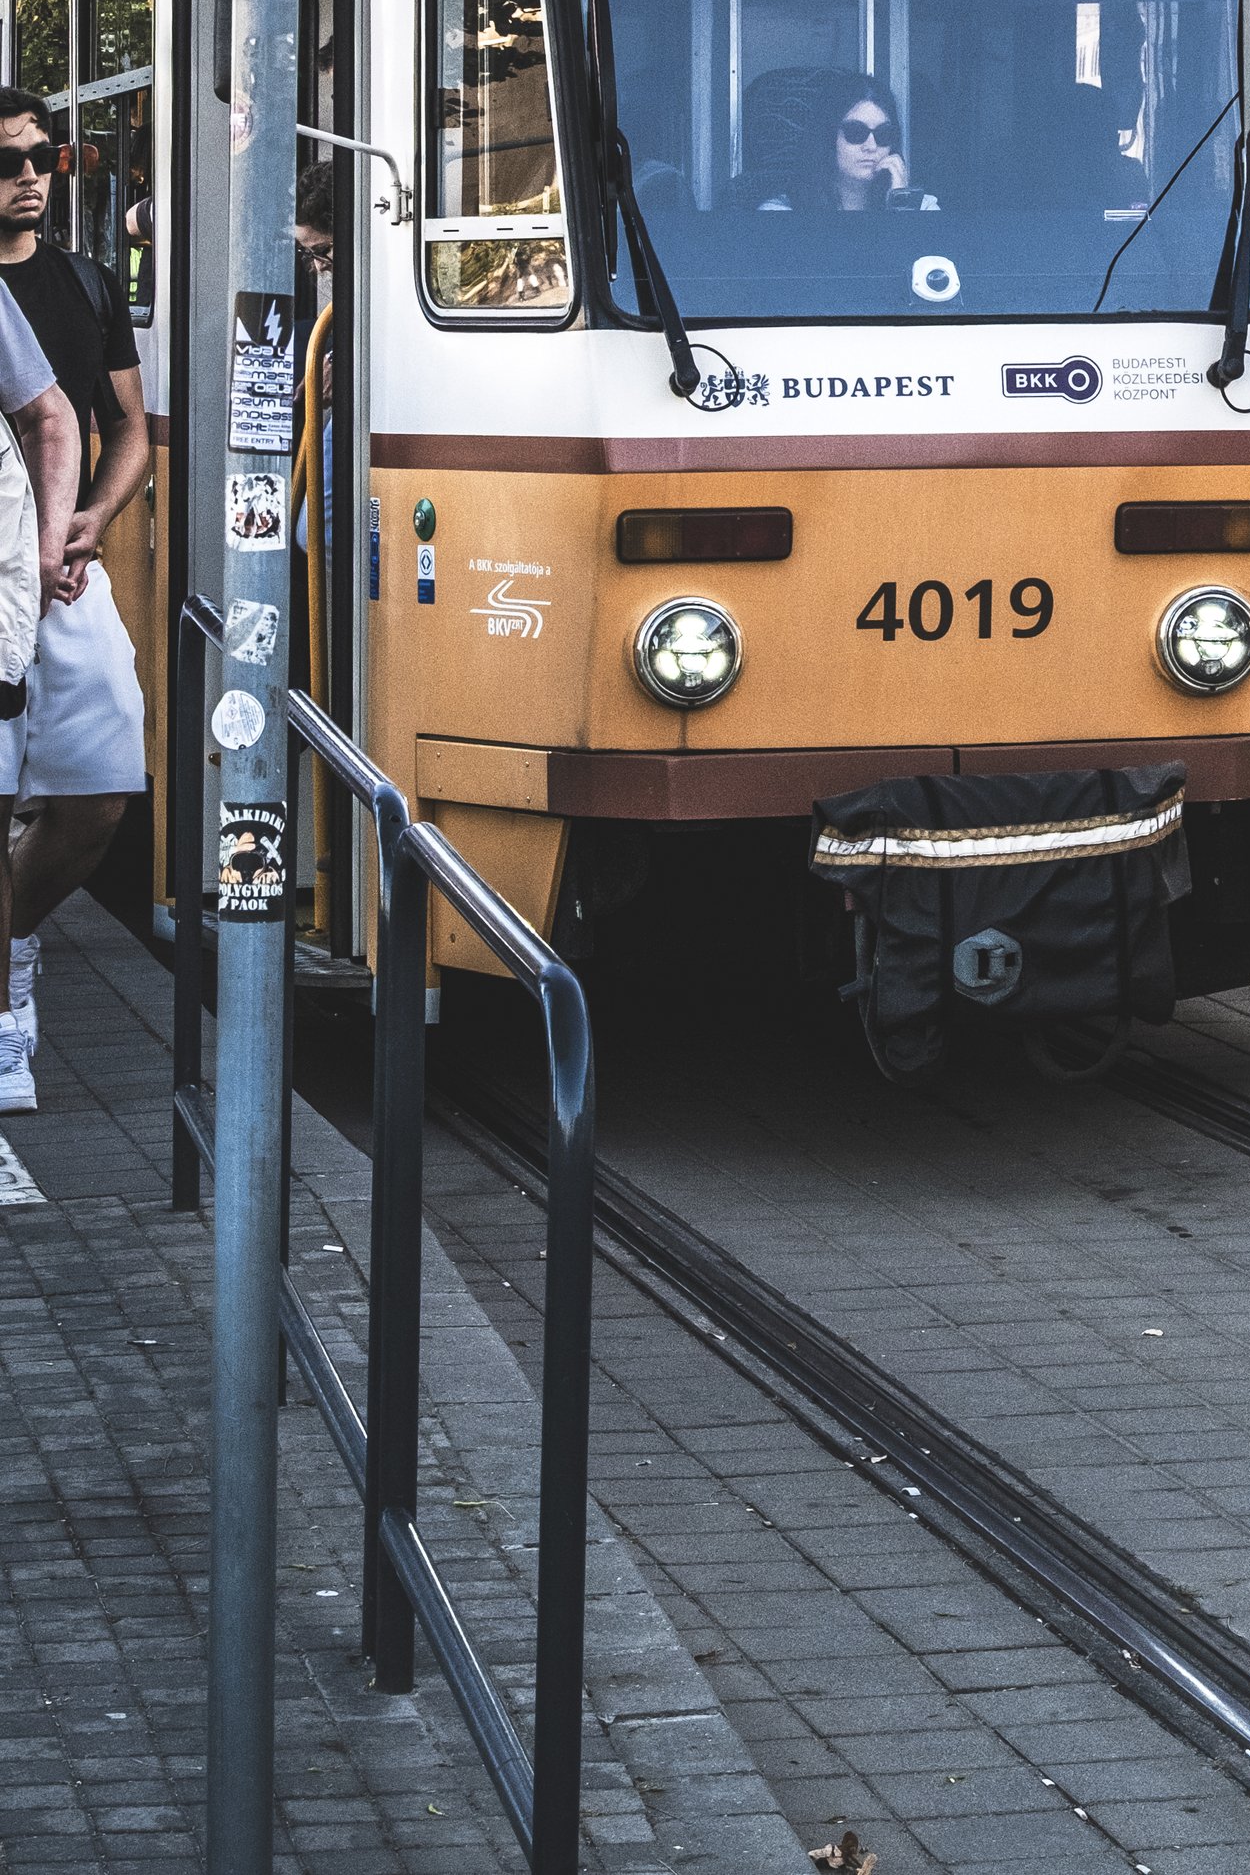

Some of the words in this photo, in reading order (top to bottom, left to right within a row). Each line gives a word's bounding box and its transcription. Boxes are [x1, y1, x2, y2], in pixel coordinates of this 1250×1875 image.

[1112, 357, 1186, 369] BUDAPESTI
[1015, 372, 1058, 388] BKK
[1113, 369, 1203, 385] KÖZLEKEDÉSI
[781, 375, 954, 398] BUDAPEST
[1114, 386, 1177, 400] KÖZPONT
[251, 437, 276, 445] ENTRY
[468, 558, 476, 571] A
[477, 558, 493, 572] BKK
[494, 559, 544, 578] szolgáltatója
[545, 565, 552, 576] a
[857, 577, 1055, 641] 4019
[221, 809, 285, 833] ALKIDIKI
[231, 898, 268, 911] PAOK
